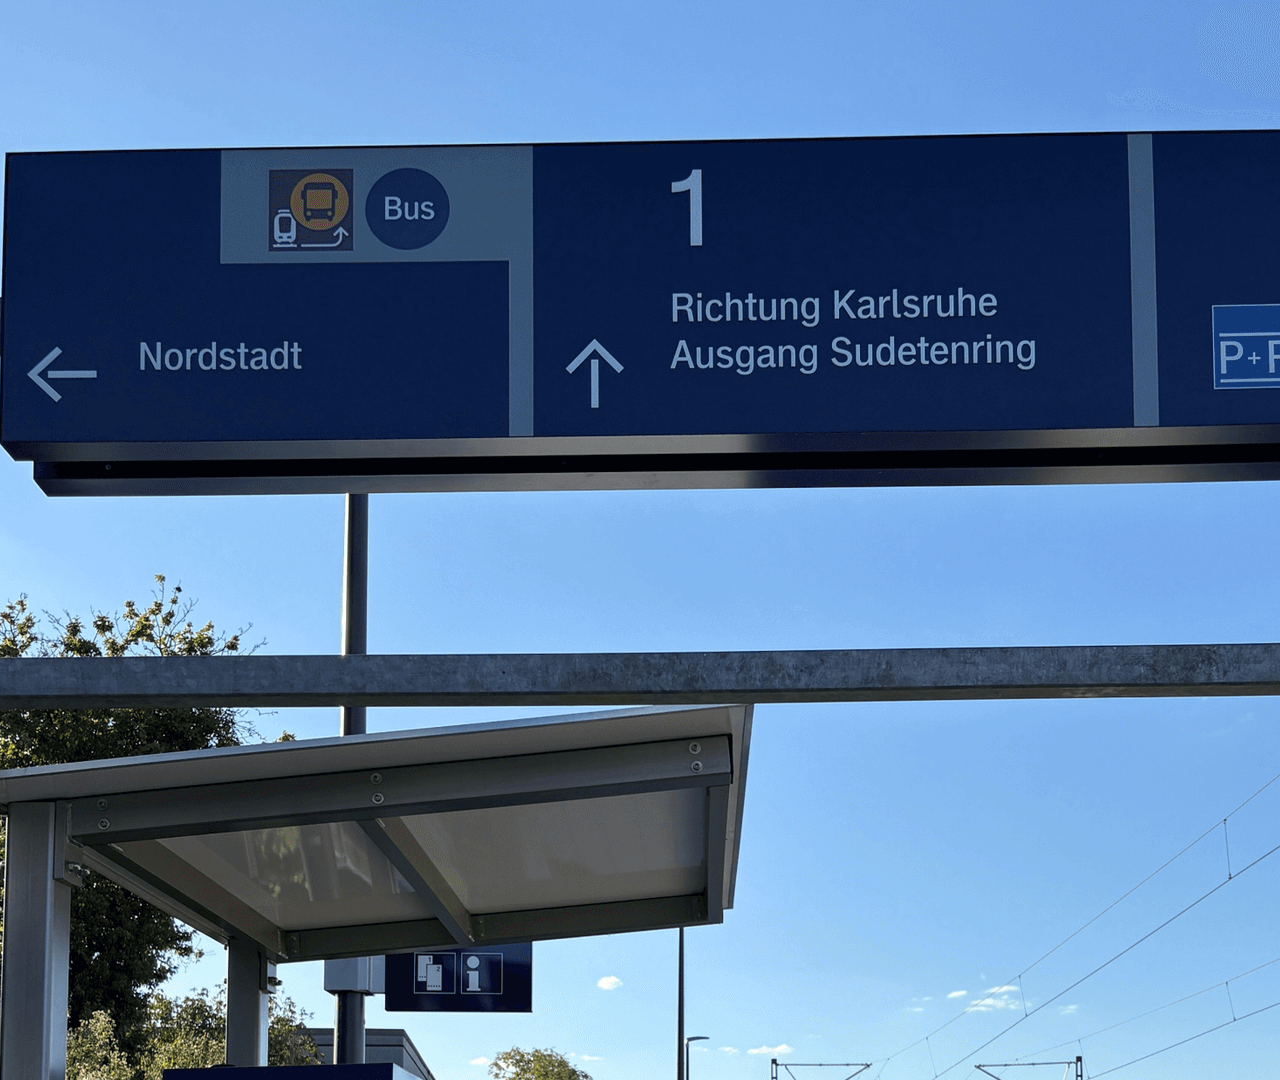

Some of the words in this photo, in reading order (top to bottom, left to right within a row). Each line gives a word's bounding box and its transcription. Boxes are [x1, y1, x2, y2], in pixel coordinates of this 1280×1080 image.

[383, 195, 436, 222] Bus
[670, 168, 703, 247] 1
[670, 291, 821, 328] Richtung
[832, 287, 998, 320] Karlsruhe
[138, 340, 303, 371] Nordstadt
[670, 339, 819, 375] Ausgang
[830, 333, 1037, 370] Sudetenring
